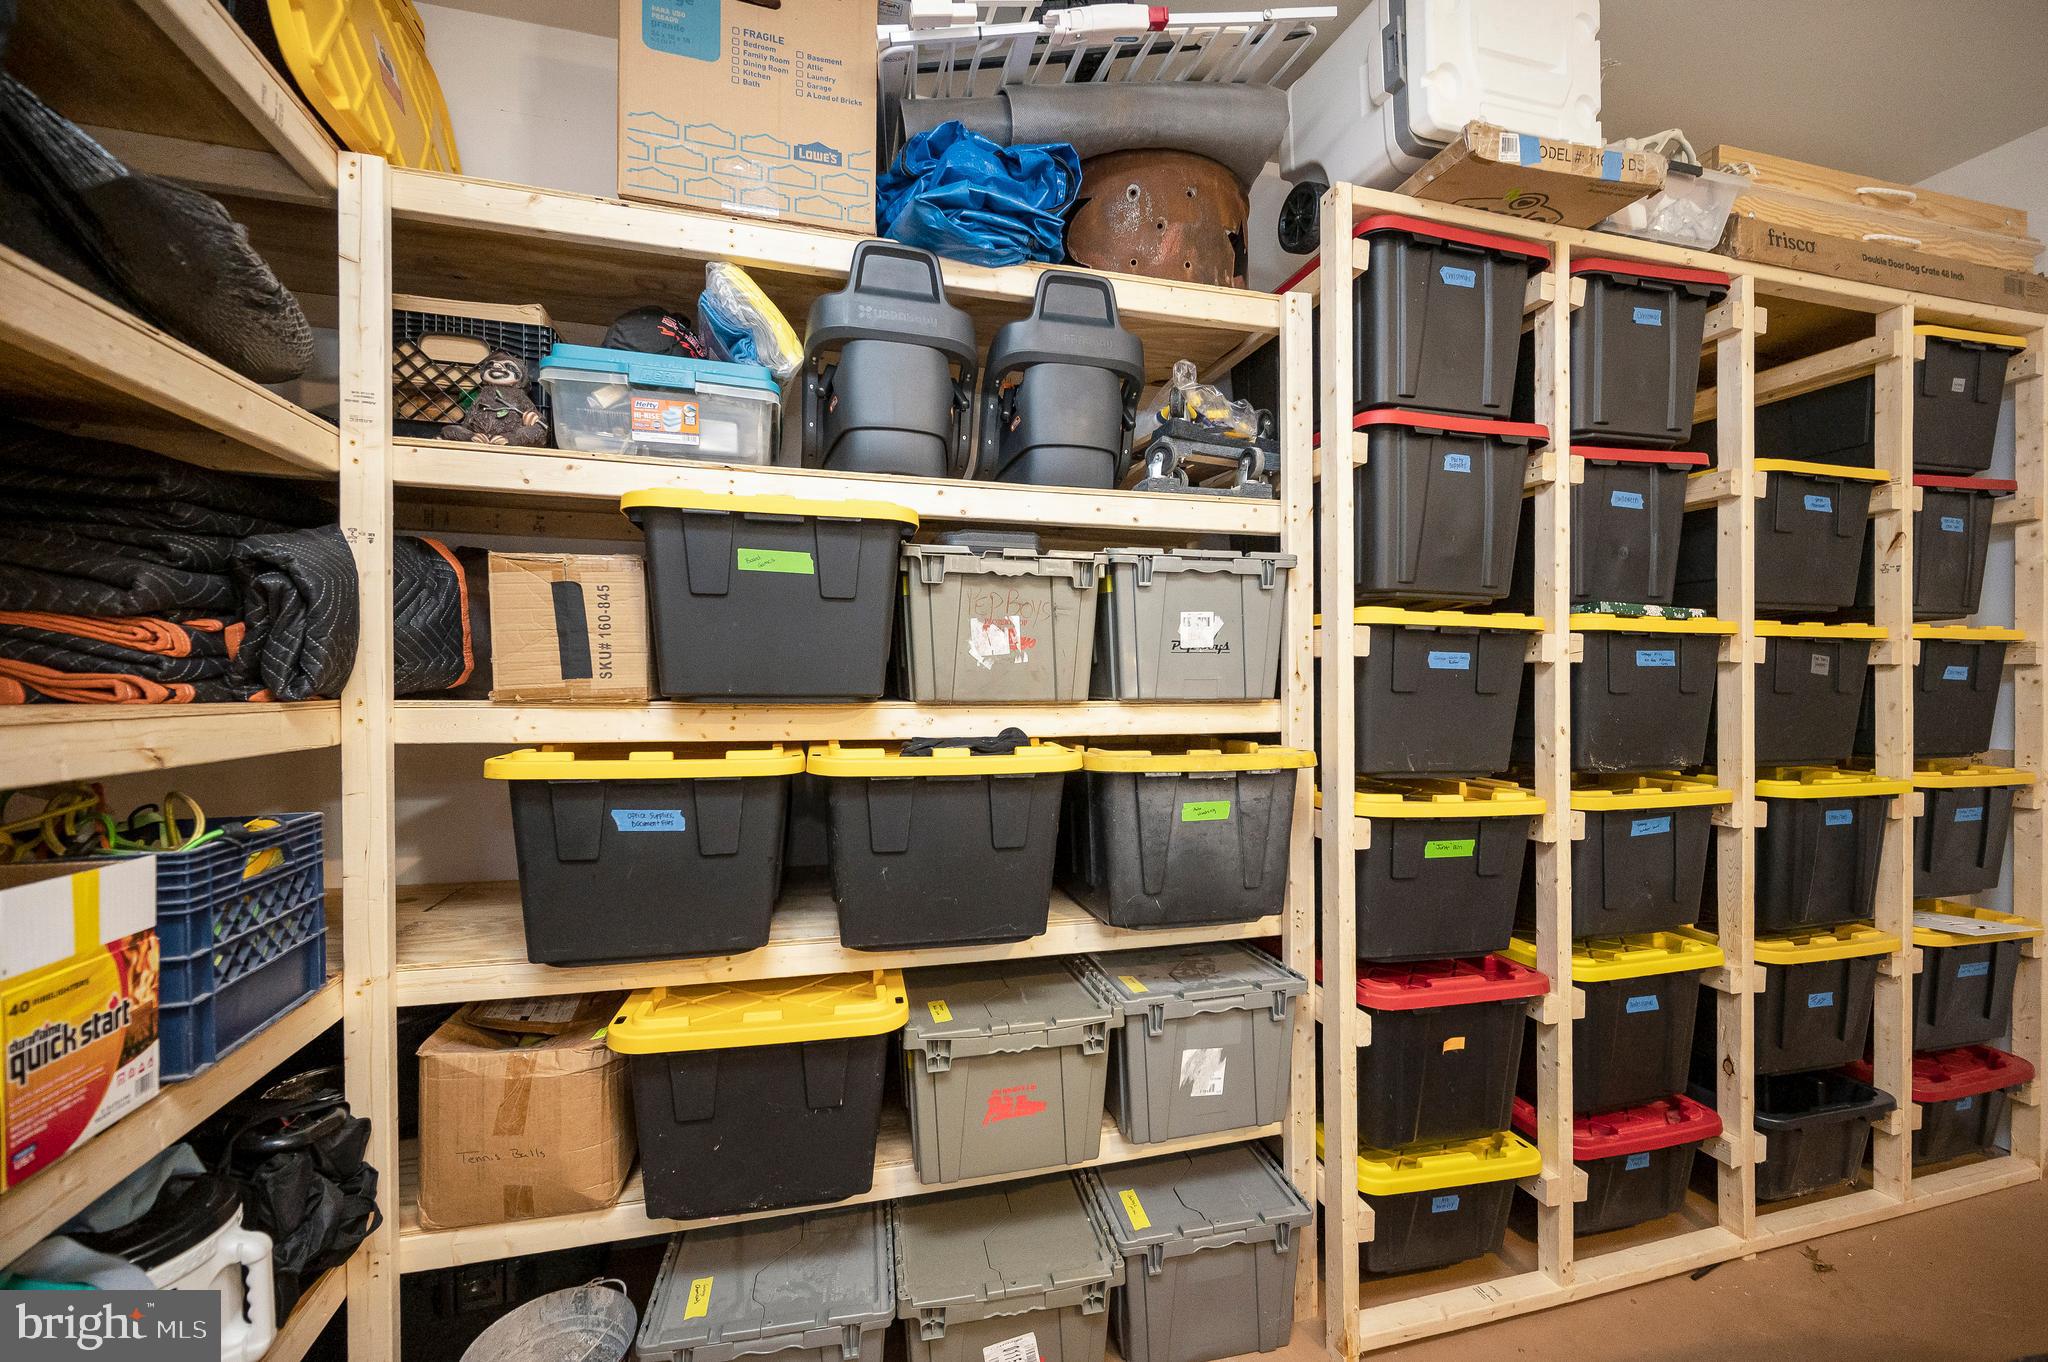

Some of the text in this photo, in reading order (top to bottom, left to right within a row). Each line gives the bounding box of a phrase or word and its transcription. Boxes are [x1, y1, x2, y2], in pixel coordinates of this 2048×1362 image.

[743, 28, 785, 46] FRAGILE
[743, 39, 777, 53] Bedroom
[743, 49, 790, 65] Family Room
[806, 54, 842, 66] Basement
[743, 59, 789, 74] Dining Room
[806, 63, 823, 72] Attic
[743, 69, 771, 81] Kitchen
[806, 72, 837, 84] Laundry
[743, 78, 760, 88] Bath
[806, 82, 832, 92] Garage
[813, 93, 830, 102] Load
[840, 97, 863, 107] Bricks
[1539, 145, 1571, 163] ODEL
[1767, 228, 1816, 254] frisco
[1862, 253, 1965, 281] Double Door Dog Crate 48 Inch
[596, 584, 613, 680] SKU# 160-845
[9, 1000, 30, 1016] 40
[10, 1000, 130, 1085] quick start
[509, 1148, 546, 1159] Balls
